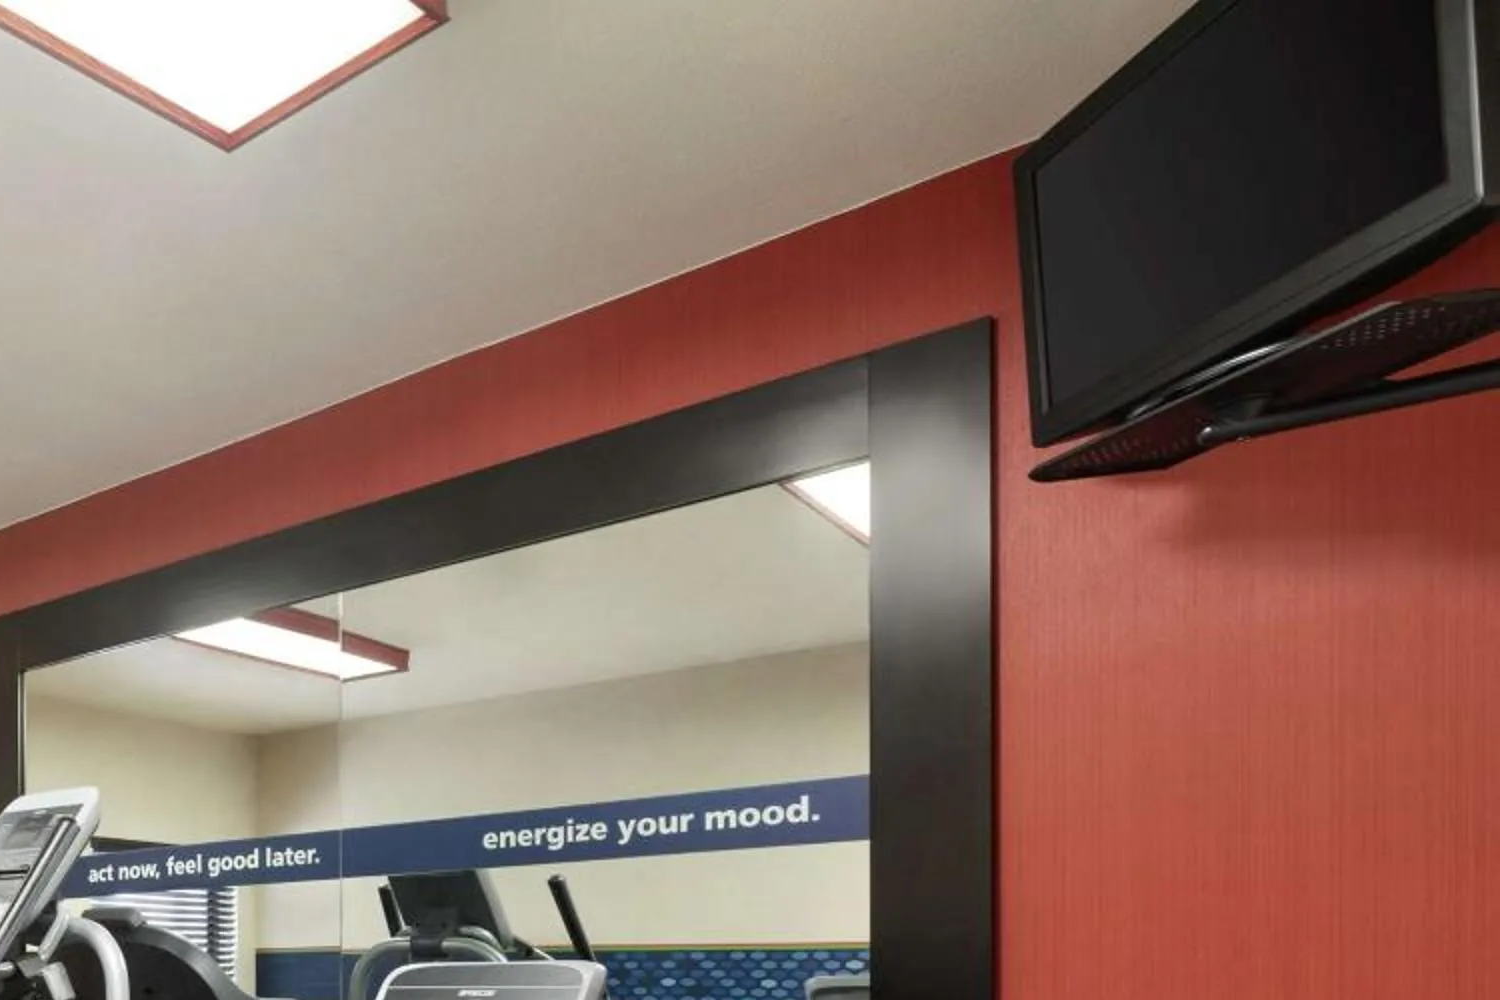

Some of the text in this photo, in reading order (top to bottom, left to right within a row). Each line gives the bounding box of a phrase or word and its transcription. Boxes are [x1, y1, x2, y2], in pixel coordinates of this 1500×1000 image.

[482, 795, 821, 851] energize your mood.
[88, 846, 321, 884] act now, feel good later.
